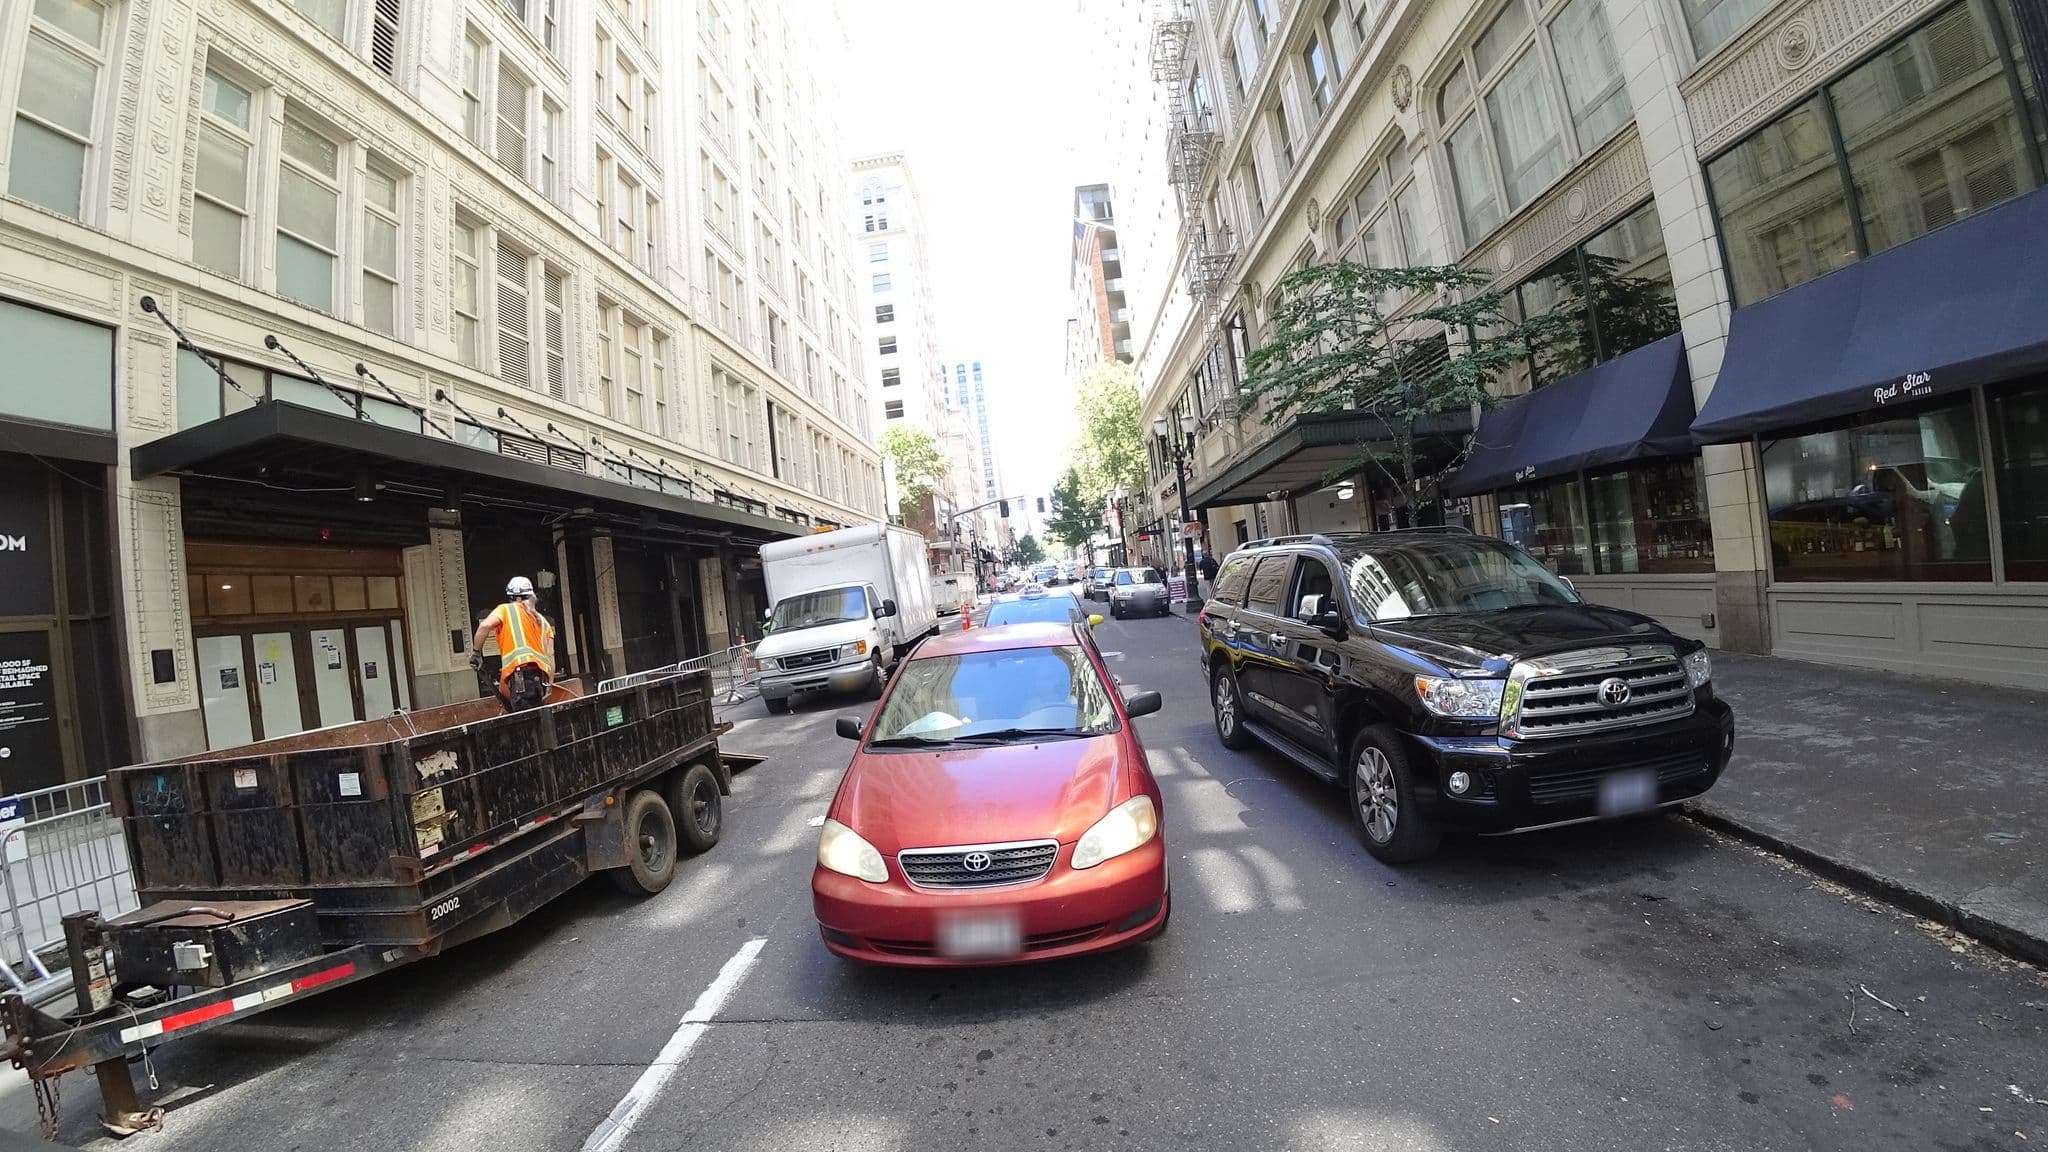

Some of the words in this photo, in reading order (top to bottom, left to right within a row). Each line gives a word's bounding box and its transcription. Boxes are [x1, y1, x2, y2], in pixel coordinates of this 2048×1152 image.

[1874, 383, 1898, 404] Red
[1902, 371, 1931, 394] Star
[2, 665, 48, 674] REIMAGINED
[17, 672, 41, 680] SPACE
[431, 897, 460, 920] 20002
